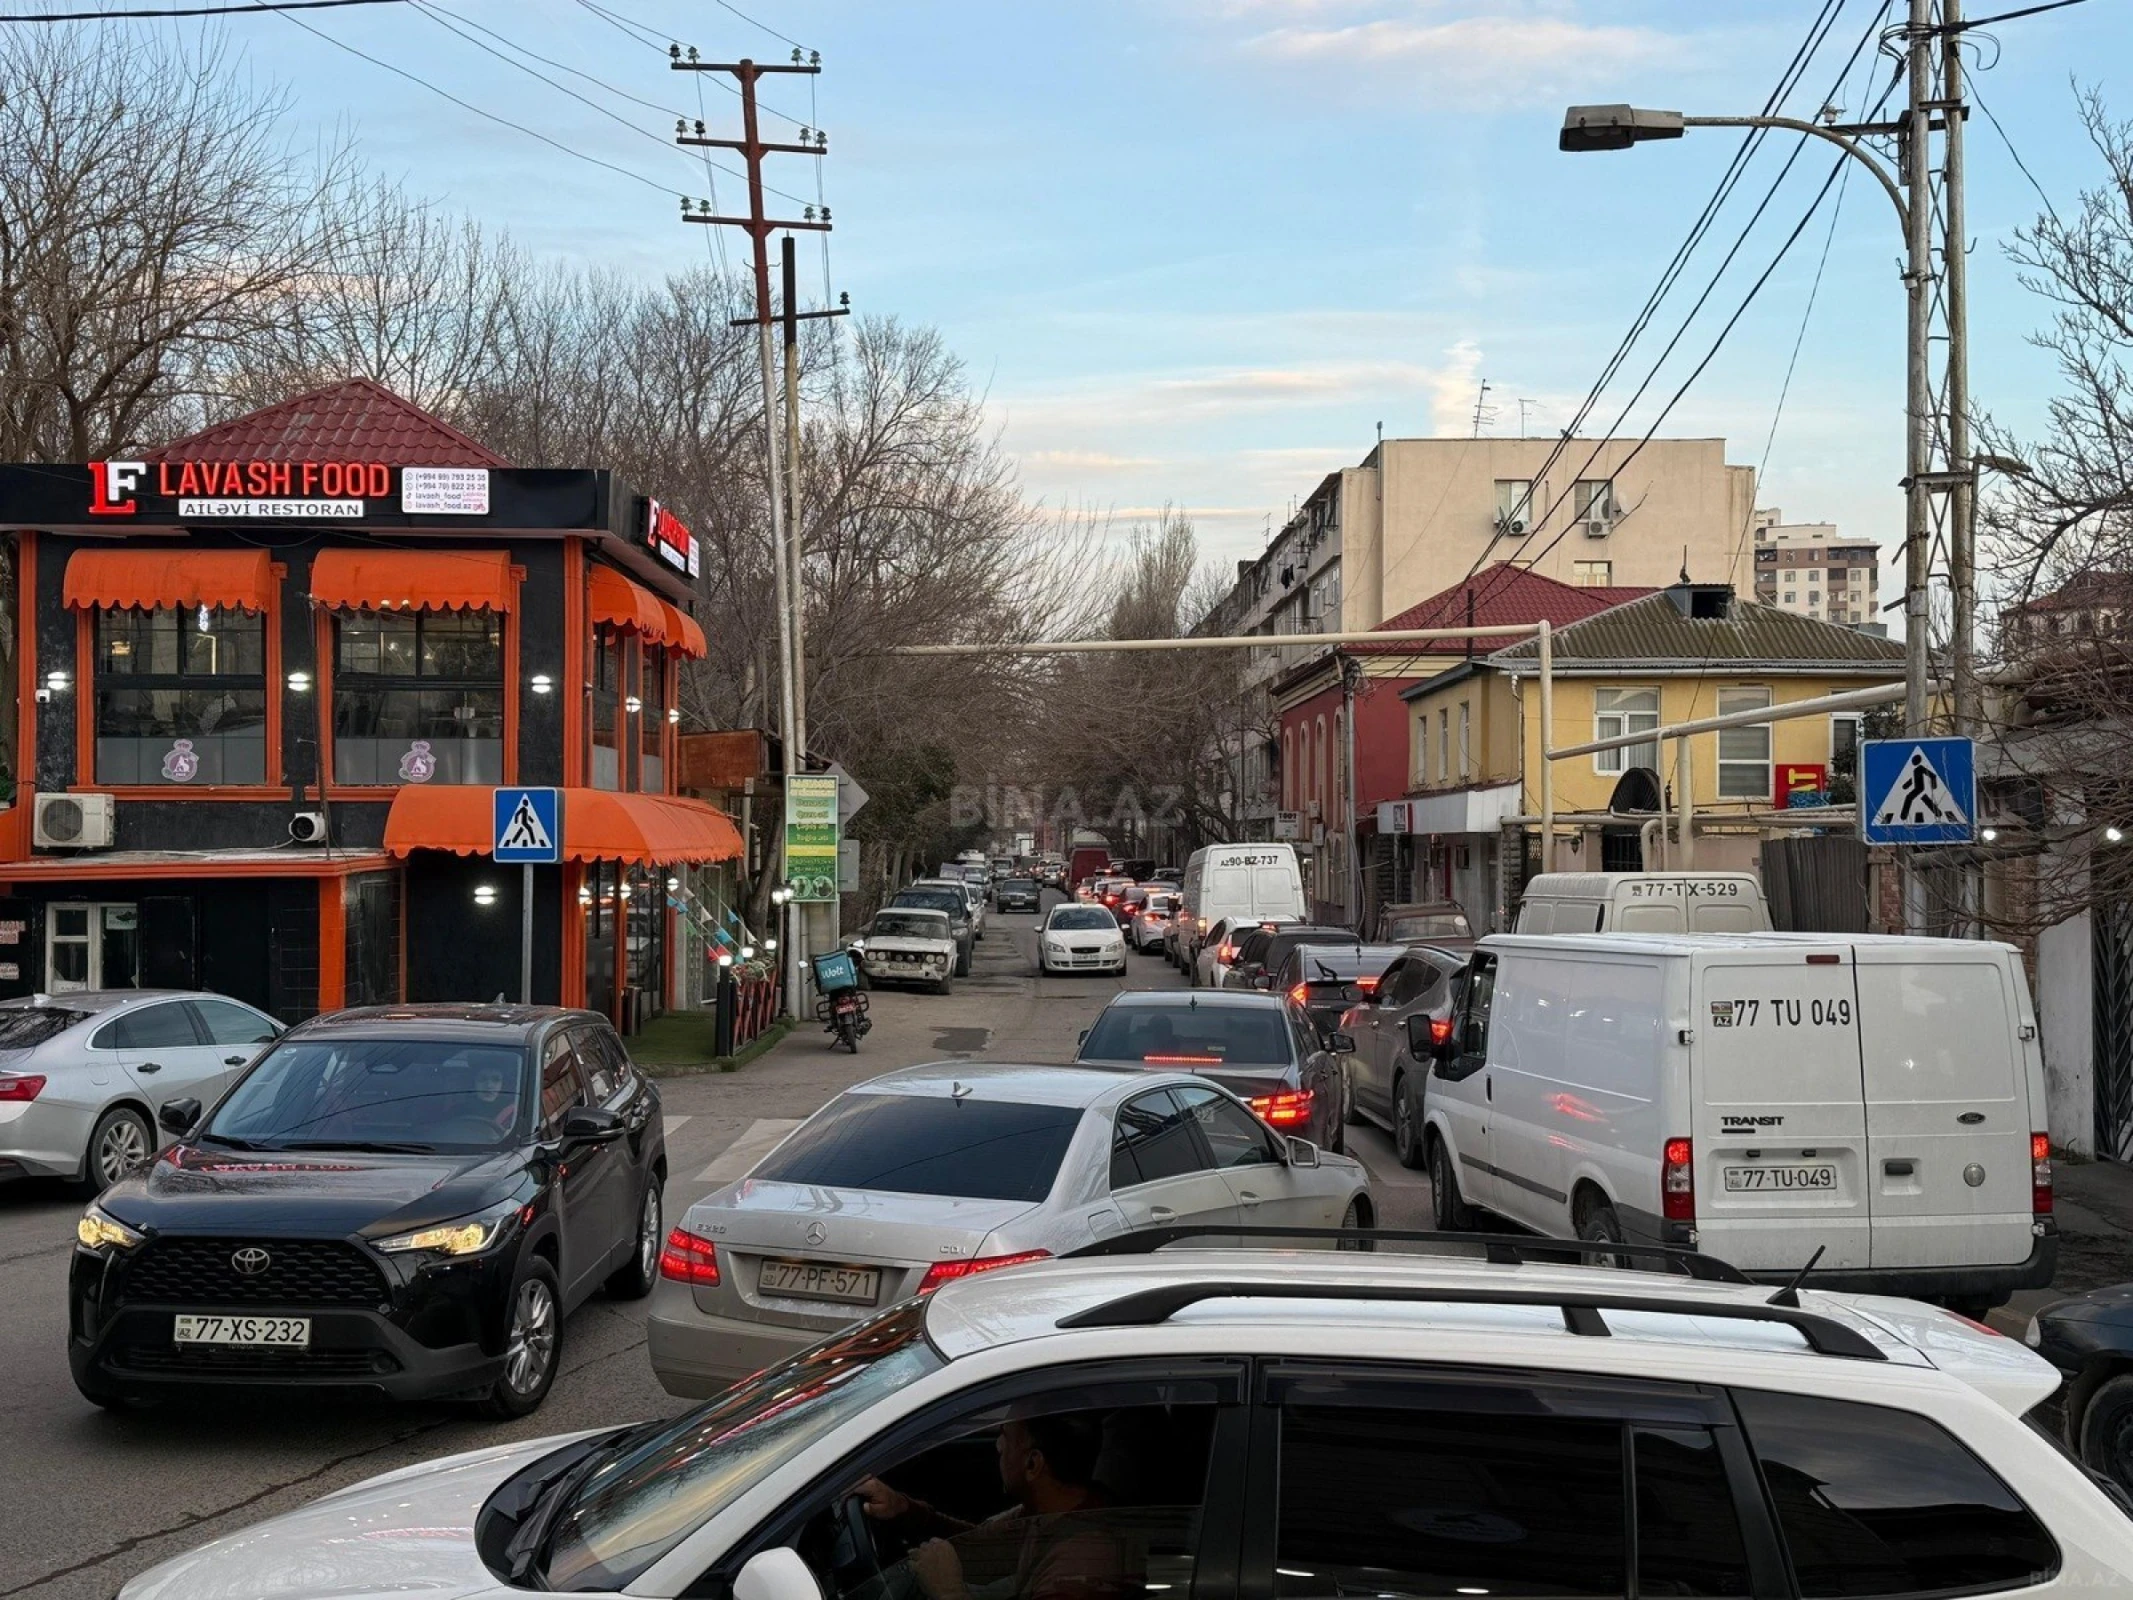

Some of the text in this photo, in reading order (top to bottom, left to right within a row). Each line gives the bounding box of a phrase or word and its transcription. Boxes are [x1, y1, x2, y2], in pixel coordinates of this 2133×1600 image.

[159, 462, 389, 497] LAVASH FOOD
[183, 500, 359, 516] AİLƏVİ RESTORAN
[1646, 883, 1738, 897] 77-TX-529
[822, 967, 845, 978] Wolt
[1734, 1000, 1760, 1026] 77
[1771, 1000, 1801, 1026] TU
[1812, 999, 1850, 1026] 049
[1721, 1117, 1785, 1126] TRANSIT
[1743, 1169, 1831, 1188] 77-TU-049
[939, 1246, 966, 1255] CDI
[777, 1265, 870, 1296] 77-PF-571
[195, 1318, 305, 1342] 77-XS-232
